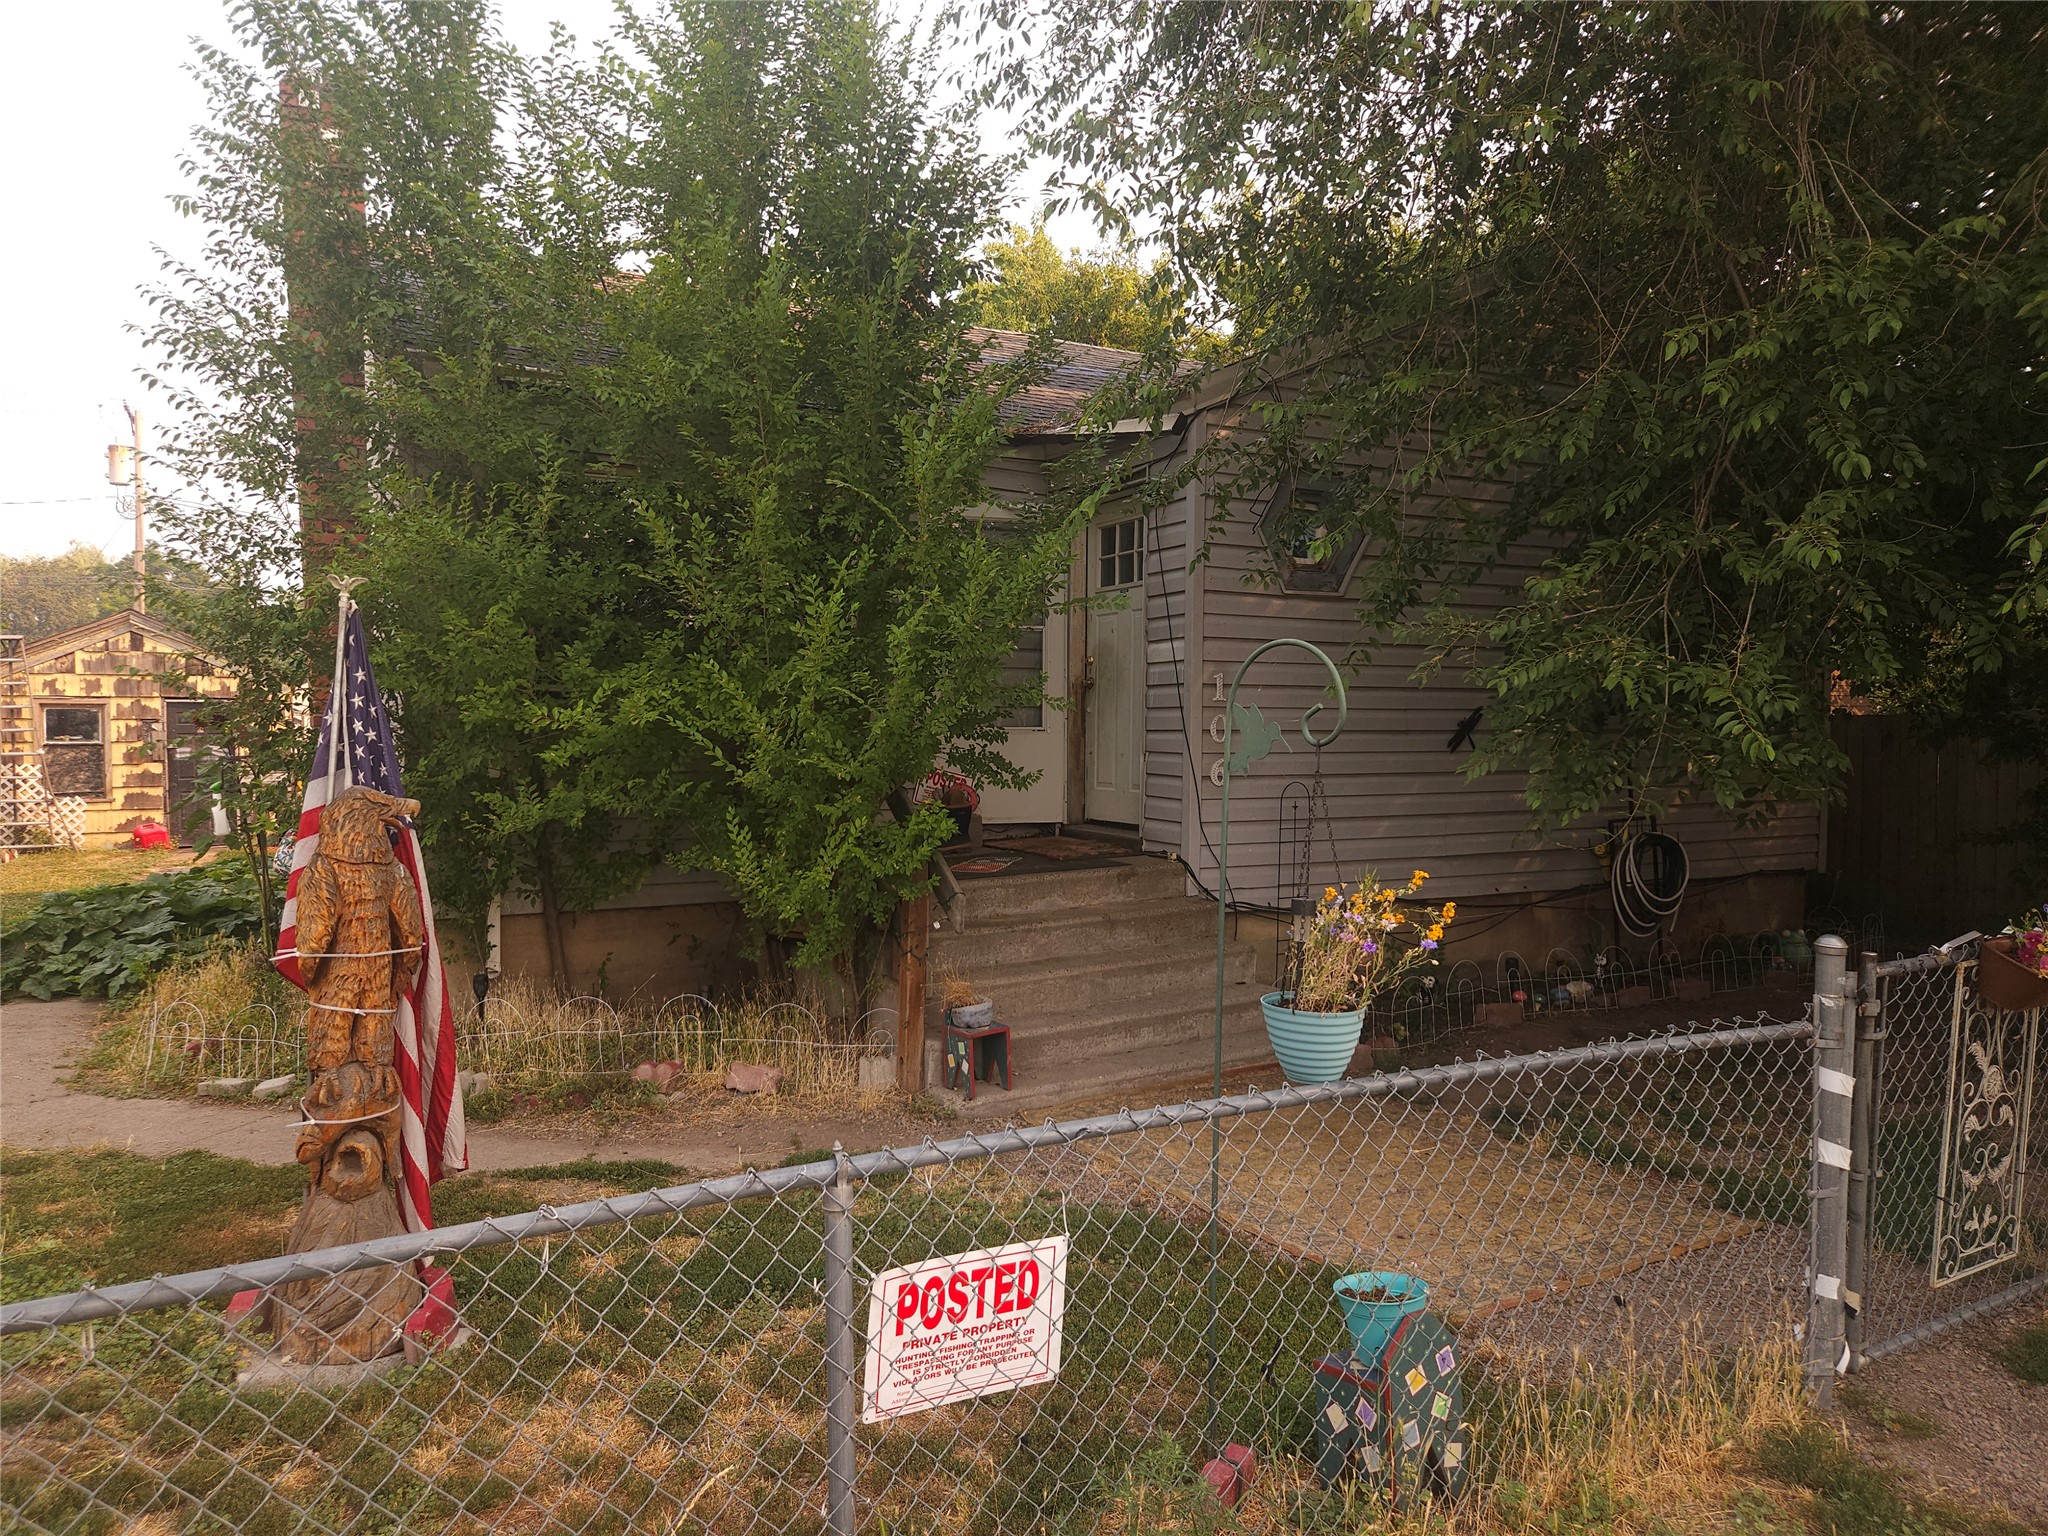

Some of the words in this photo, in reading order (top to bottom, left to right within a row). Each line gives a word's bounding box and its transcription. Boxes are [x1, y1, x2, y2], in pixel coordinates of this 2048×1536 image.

[895, 1258, 1039, 1337] POSTED
[902, 1330, 958, 1350] PRIVATE
[962, 1316, 1028, 1338] PROPERTY
[1023, 1328, 1035, 1337] OR
[893, 1371, 941, 1388] VIOLATORS
[944, 1365, 963, 1375] WILL
[966, 1362, 978, 1370] BE
[980, 1350, 1036, 1367] PROSECUTED
[897, 1353, 955, 1371] TRESPASSING
[957, 1348, 974, 1357] FOR
[977, 1344, 993, 1353] ANY
[996, 1336, 1034, 1349] PURPOSE
[924, 1358, 966, 1372] STRICTLY
[968, 1347, 1017, 1362] FORBIDDEN
